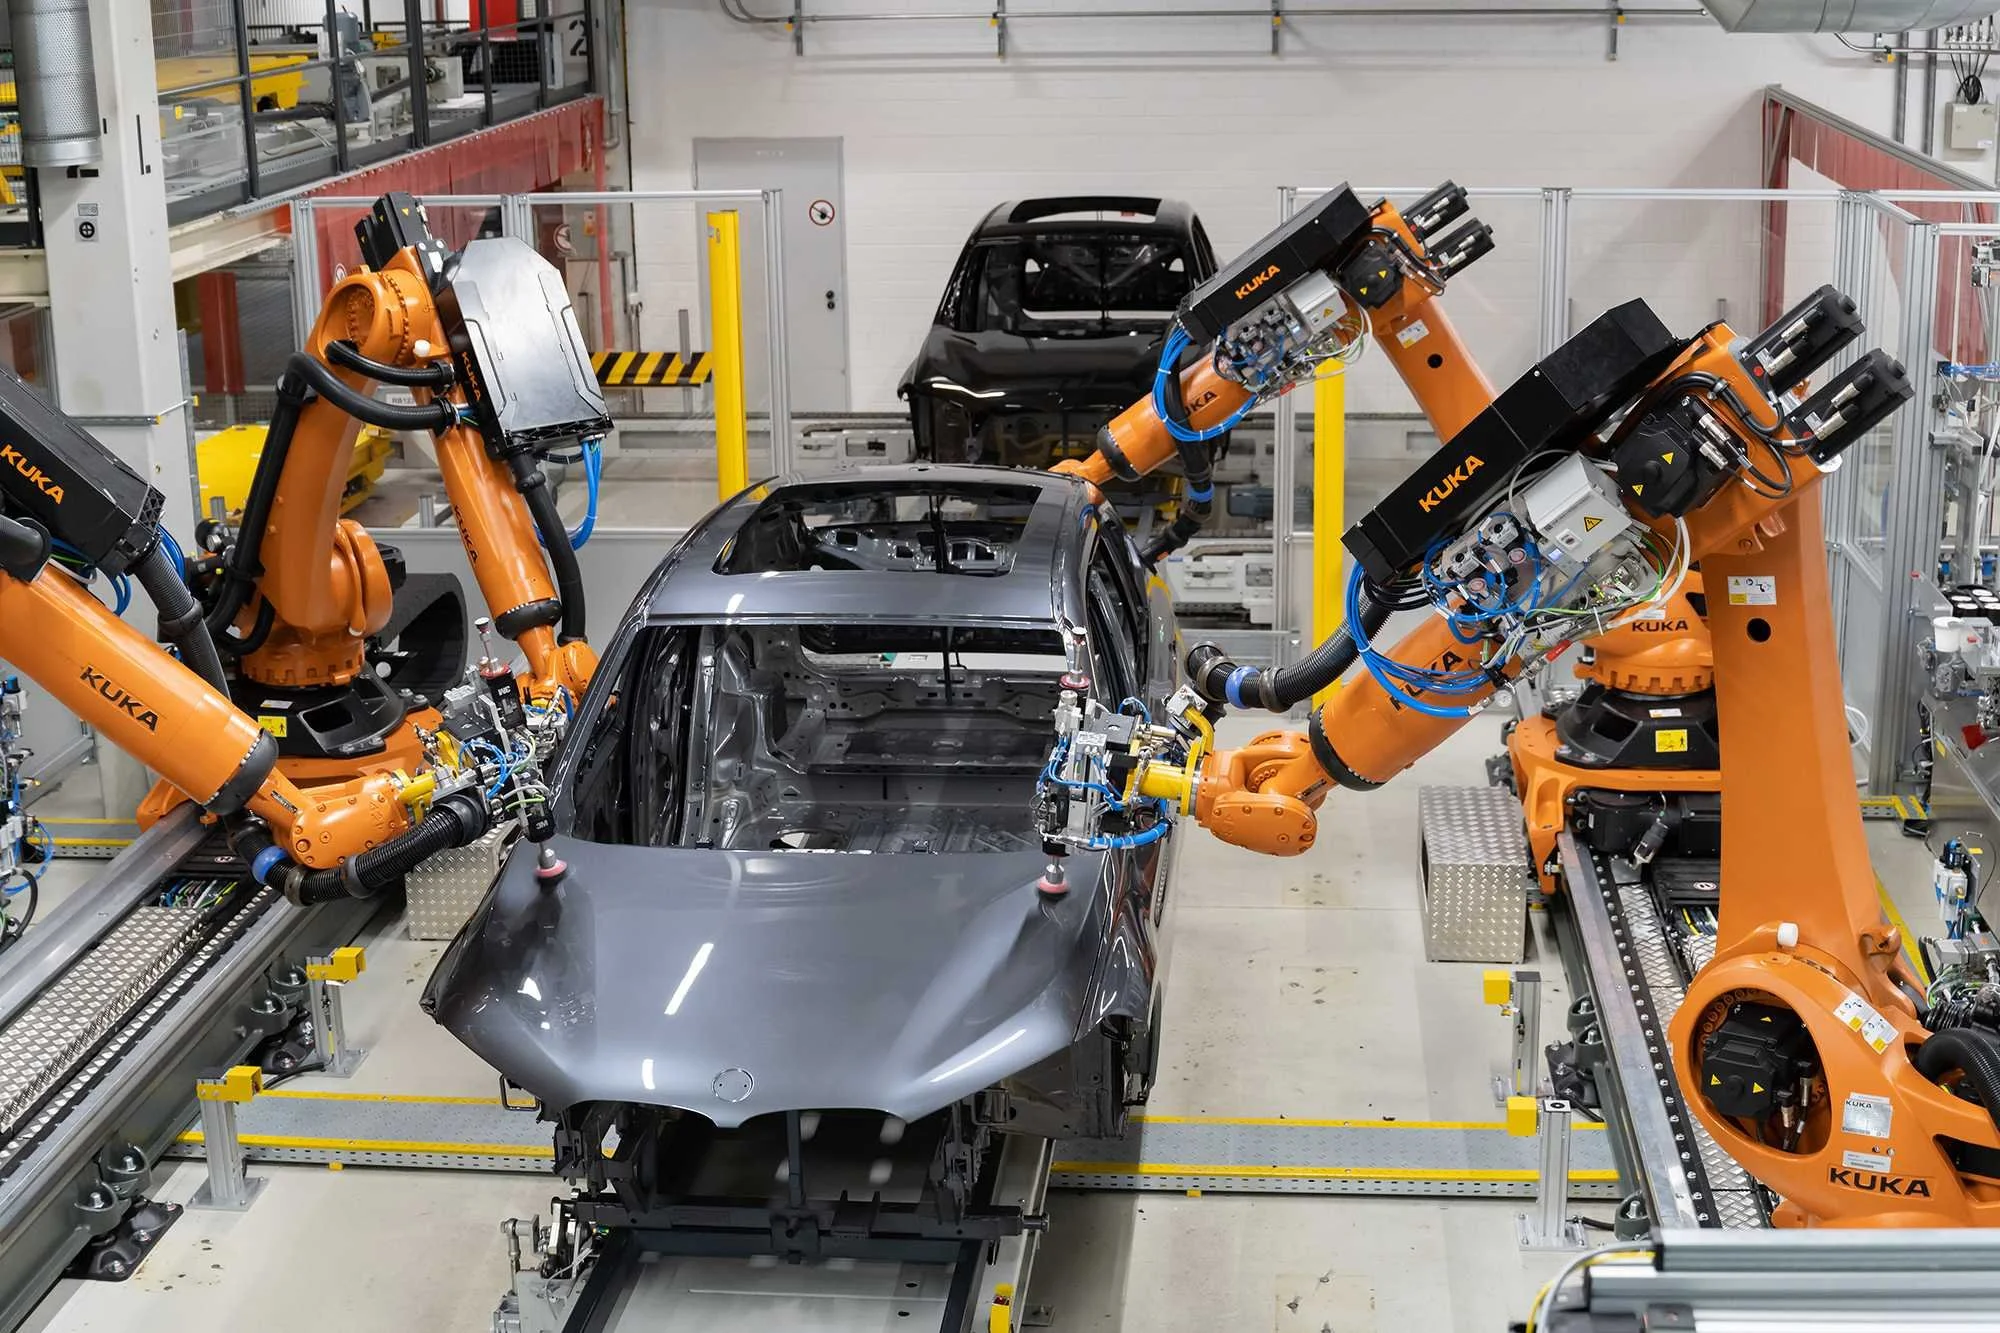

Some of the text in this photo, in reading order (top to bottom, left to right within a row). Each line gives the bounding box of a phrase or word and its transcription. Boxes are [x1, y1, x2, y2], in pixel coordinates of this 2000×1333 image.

[1235, 265, 1280, 299] KUKA
[462, 352, 481, 401] KUKA
[0, 444, 64, 504] KUKA
[1419, 455, 1485, 513] KUKA
[455, 504, 478, 562] KUKA
[1632, 620, 1688, 632] KUKA
[80, 667, 159, 731] KUKA
[1845, 1100, 1872, 1109] KUKA
[1829, 1167, 1930, 1197] KUKA
